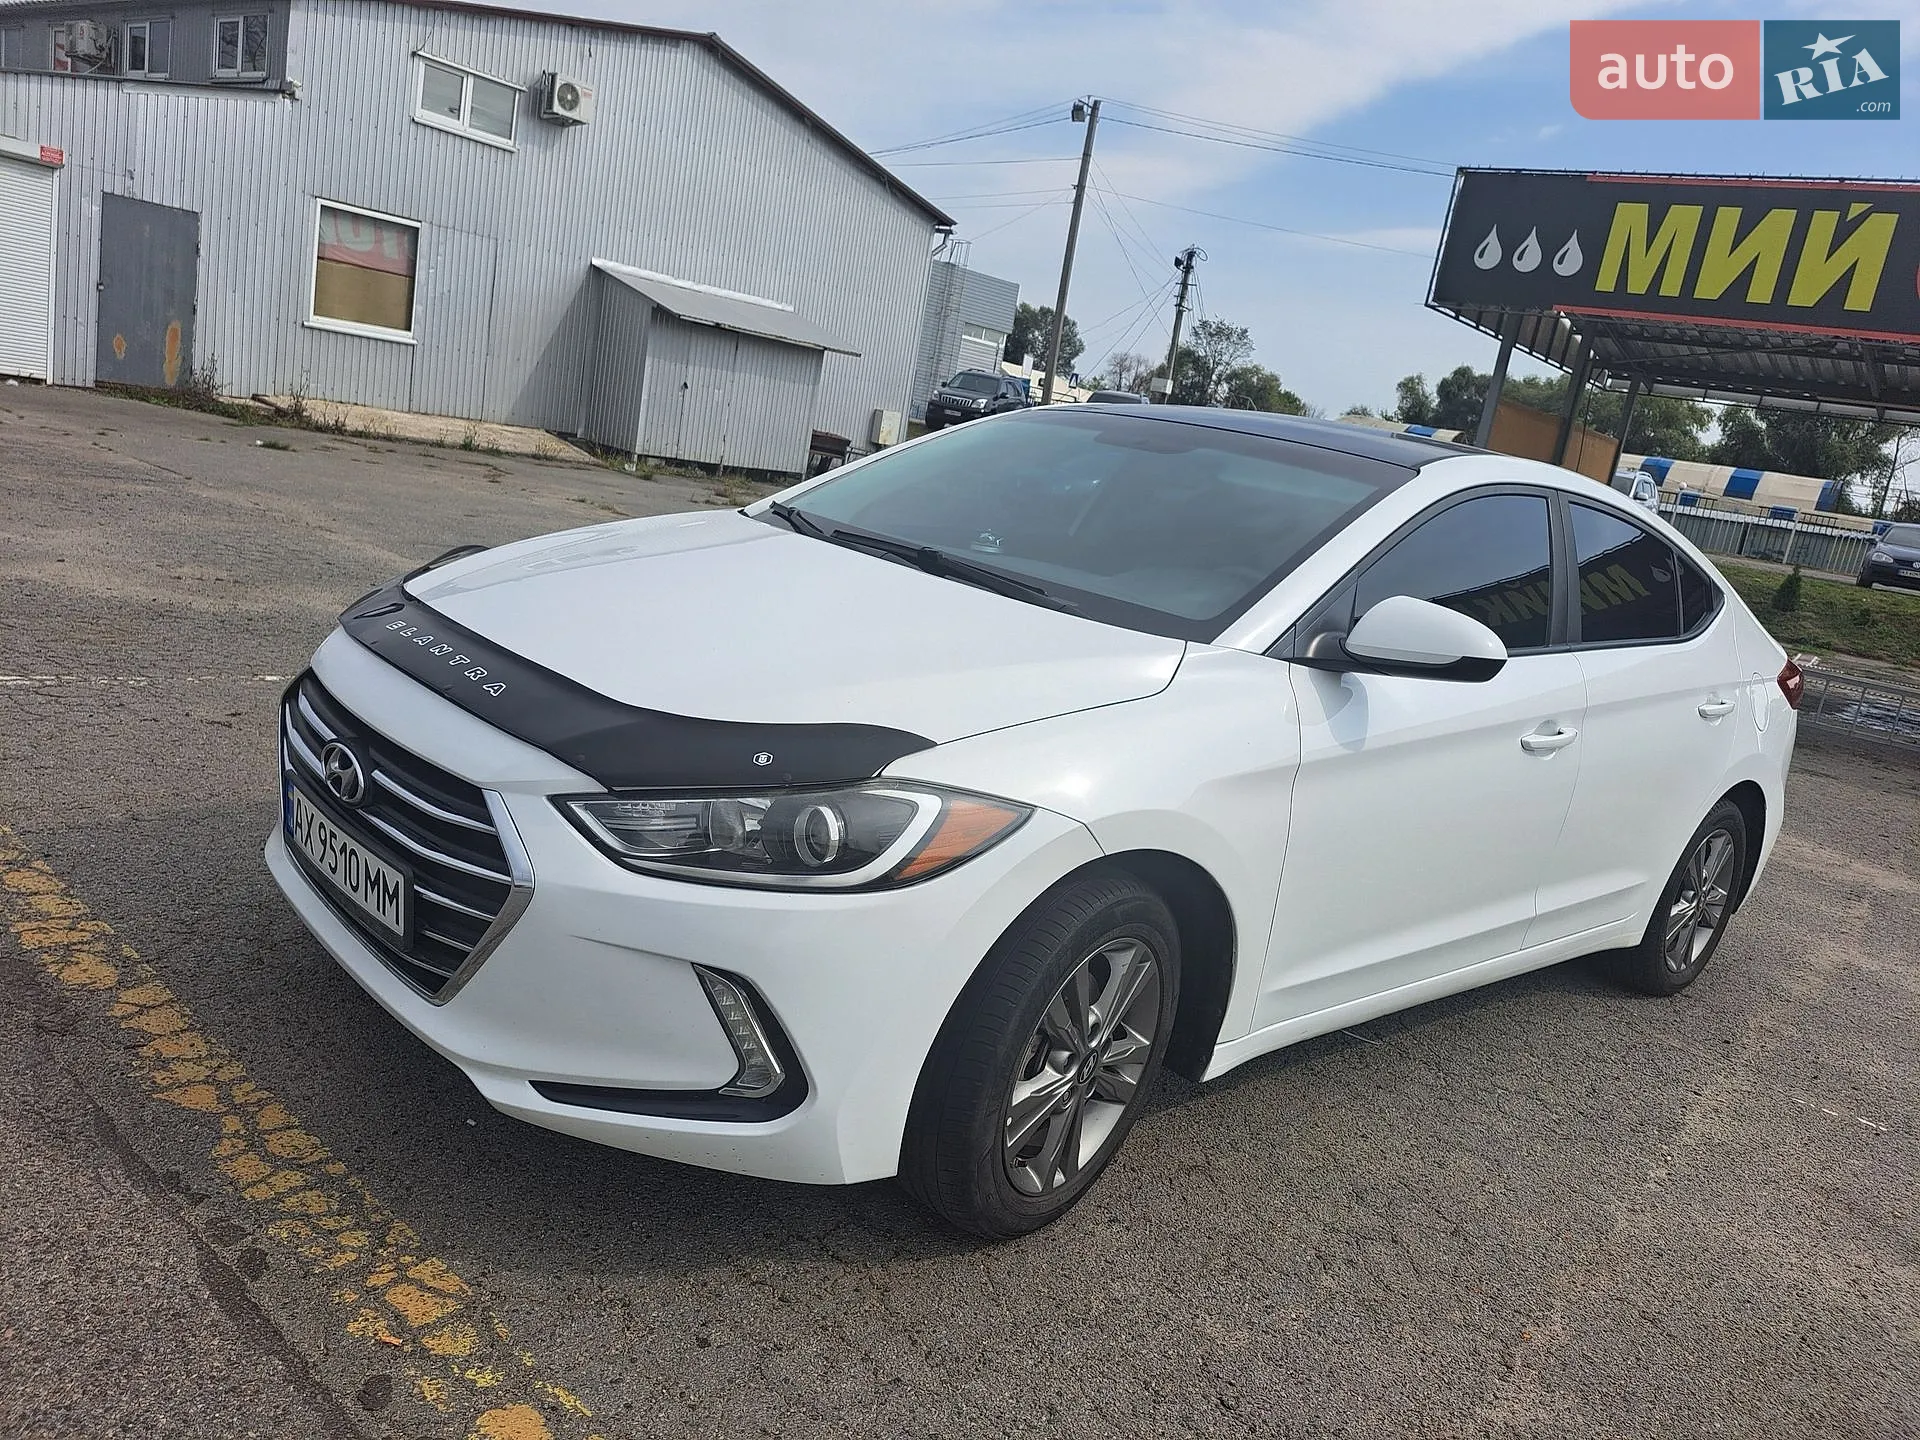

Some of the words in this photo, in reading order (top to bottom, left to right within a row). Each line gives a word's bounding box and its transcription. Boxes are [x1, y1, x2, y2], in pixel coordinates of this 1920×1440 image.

[1594, 201, 1900, 313] МИЙ
[385, 620, 507, 697] ELANTRA
[294, 797, 316, 857] AX
[318, 821, 360, 894] 9510
[364, 856, 400, 927] MM
